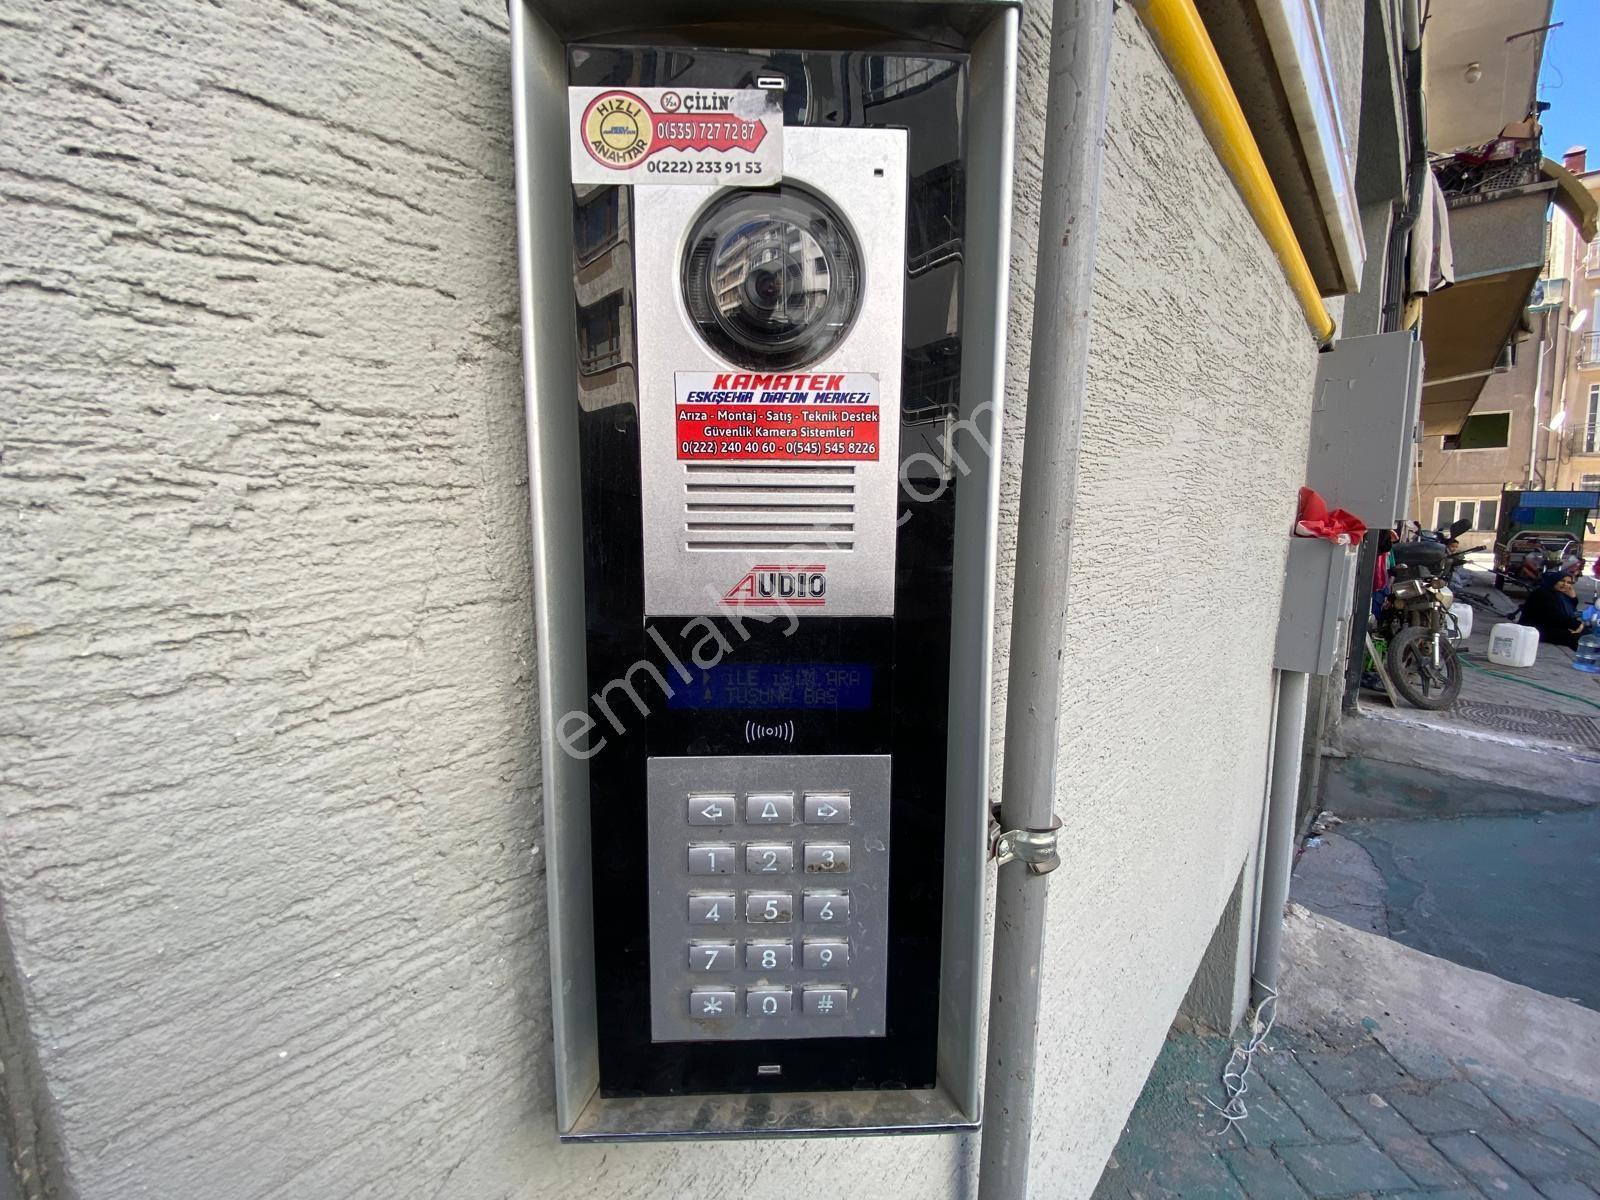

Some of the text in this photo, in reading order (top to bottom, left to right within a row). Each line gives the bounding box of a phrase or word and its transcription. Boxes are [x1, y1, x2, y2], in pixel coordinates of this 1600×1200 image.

[597, 99, 641, 117] HIZLI
[683, 91, 734, 114] ÇİLİN
[658, 121, 755, 139] 0(535) 727 72 87
[591, 139, 648, 163] ANAHTAR
[648, 161, 762, 174] 0(222) 233 91 53
[713, 374, 846, 391] KAMATEK
[679, 411, 707, 421] Arıza
[717, 412, 756, 423] Montaj
[767, 412, 792, 423] Satış
[802, 412, 837, 421] Teknik
[842, 412, 878, 422] Destek
[704, 427, 854, 437] Güvenlik Kamera Sistemleri
[682, 443, 717, 455] 0(222)
[722, 443, 741, 452] 240
[745, 443, 759, 452] 40
[762, 443, 776, 452] 60
[786, 443, 821, 455] 0(545)
[825, 444, 845, 453] 545
[848, 444, 875, 453] 8226
[723, 572, 826, 598] AUDIO
[708, 850, 835, 872] 1 2 3
[705, 900, 834, 921] 4 5 6
[705, 949, 833, 970] 7 8 9
